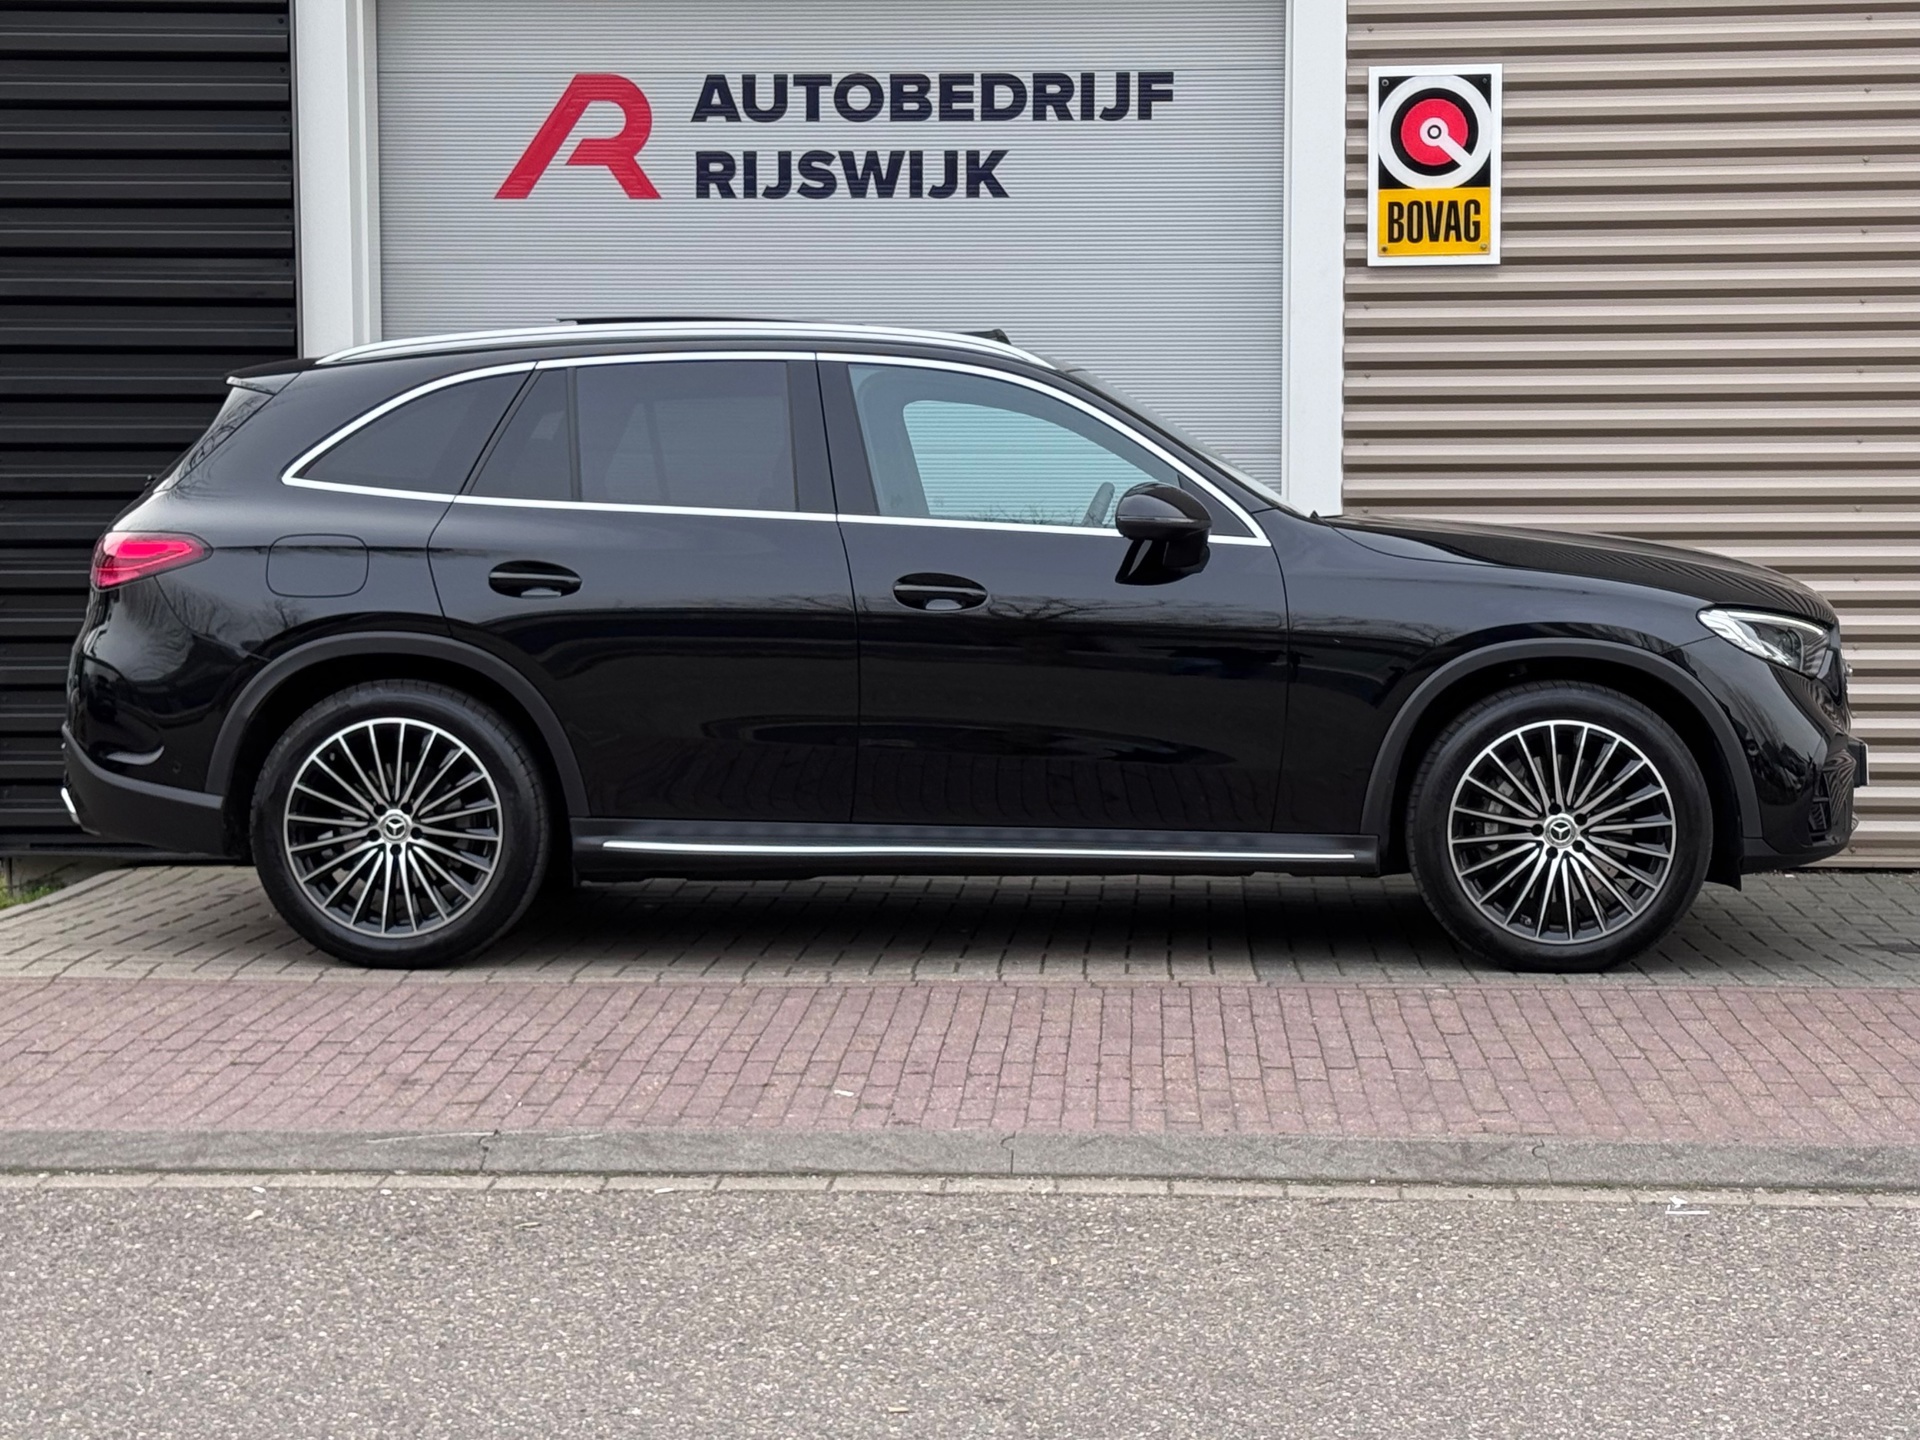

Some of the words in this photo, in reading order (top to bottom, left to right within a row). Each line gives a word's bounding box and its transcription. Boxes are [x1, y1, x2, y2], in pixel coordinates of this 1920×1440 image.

[691, 71, 1174, 122] AUTOBEDRIJF
[696, 150, 1009, 200] RIJSWIJK
[1387, 199, 1481, 243] BOVAG
